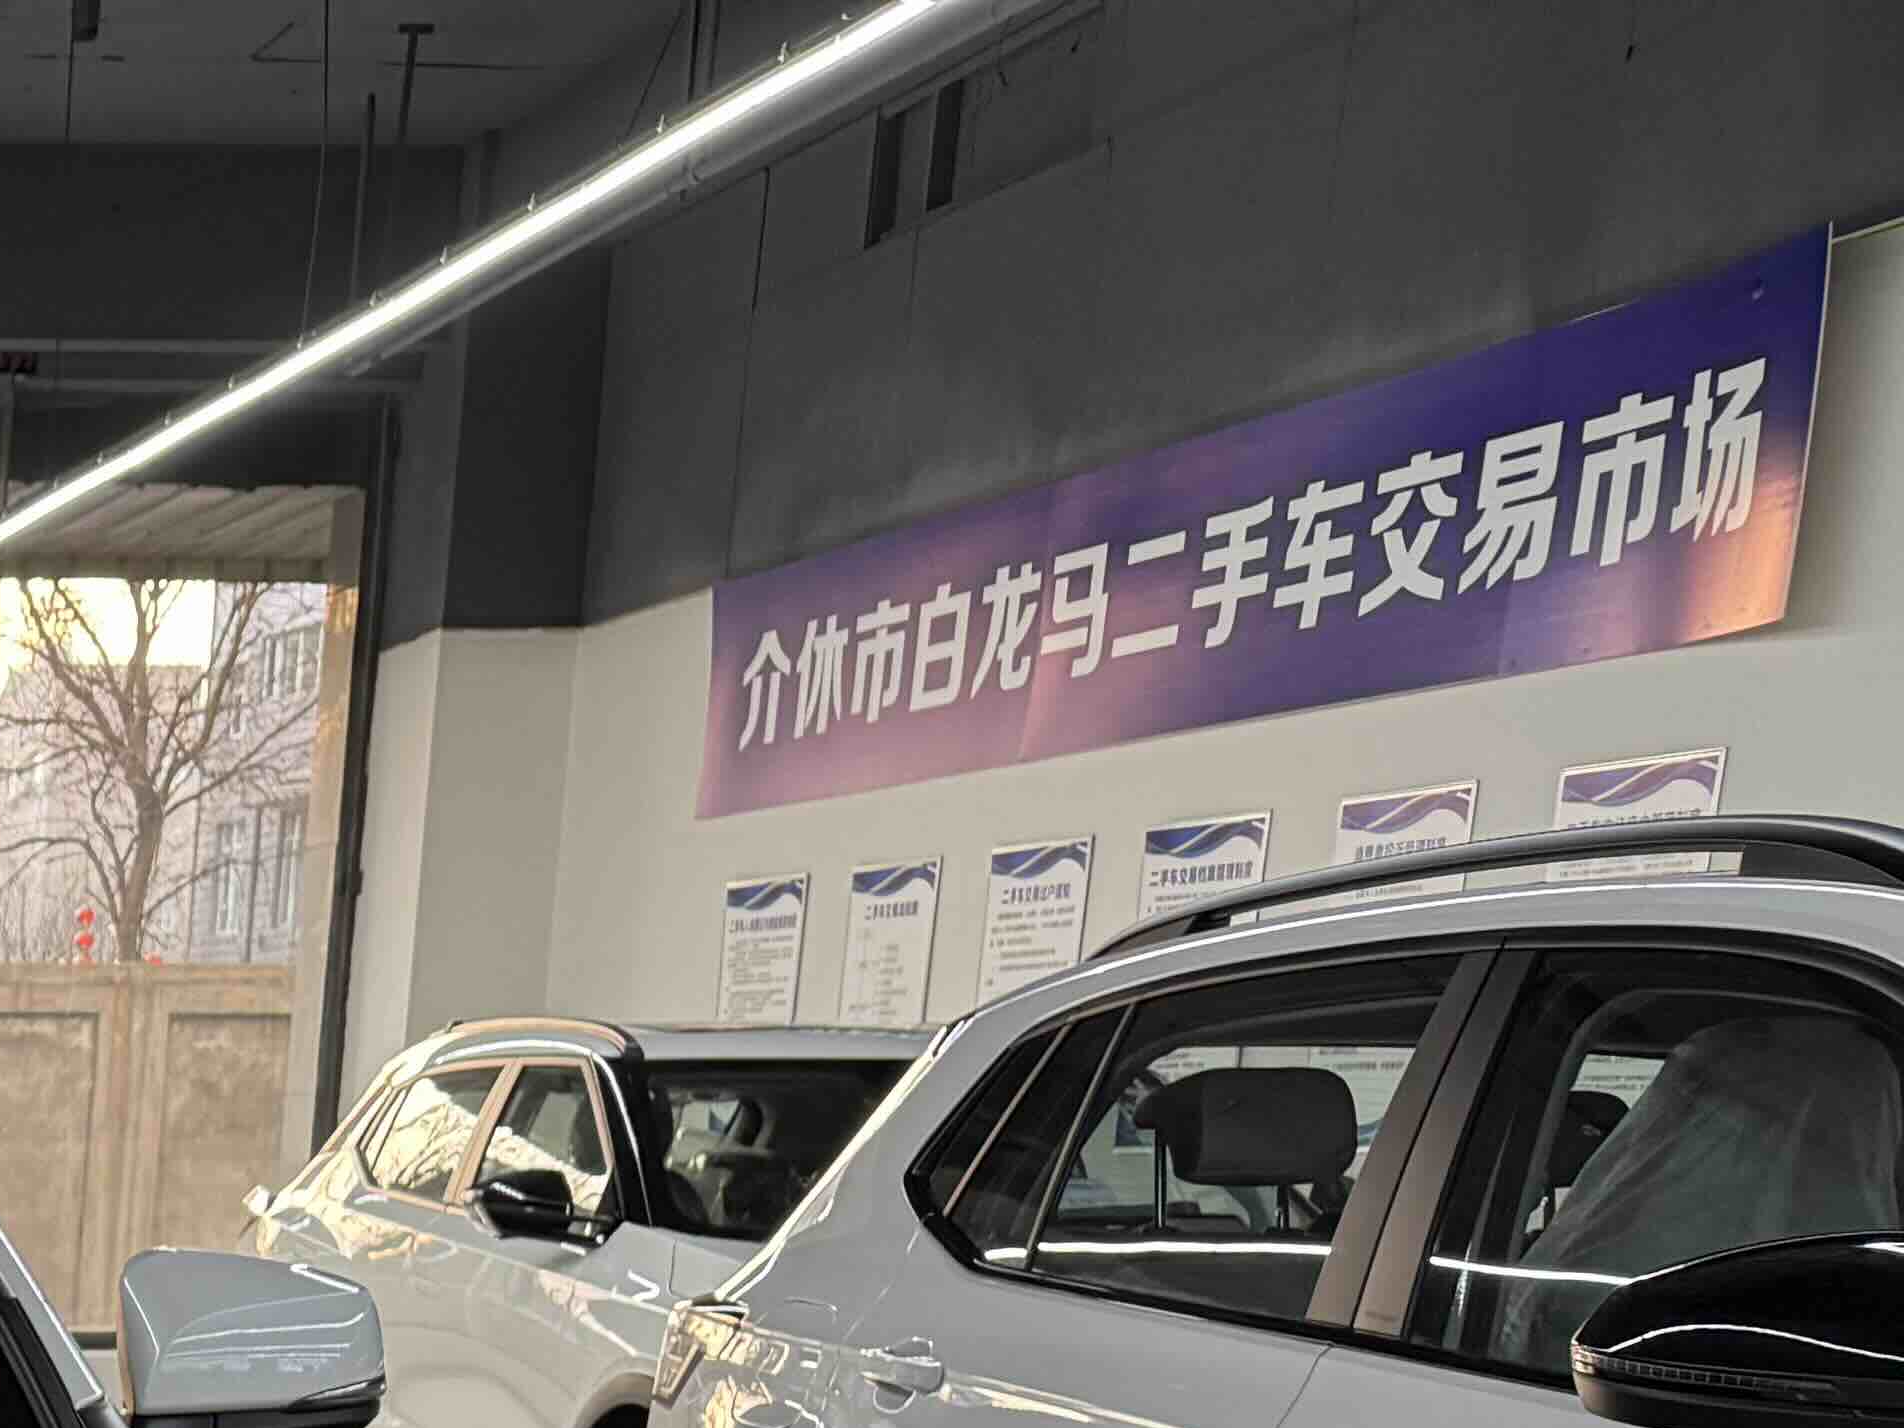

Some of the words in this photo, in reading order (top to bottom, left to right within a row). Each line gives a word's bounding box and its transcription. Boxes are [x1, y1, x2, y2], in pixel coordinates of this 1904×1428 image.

[738, 357, 1768, 752] 介休市白龙马二手车交易市场
